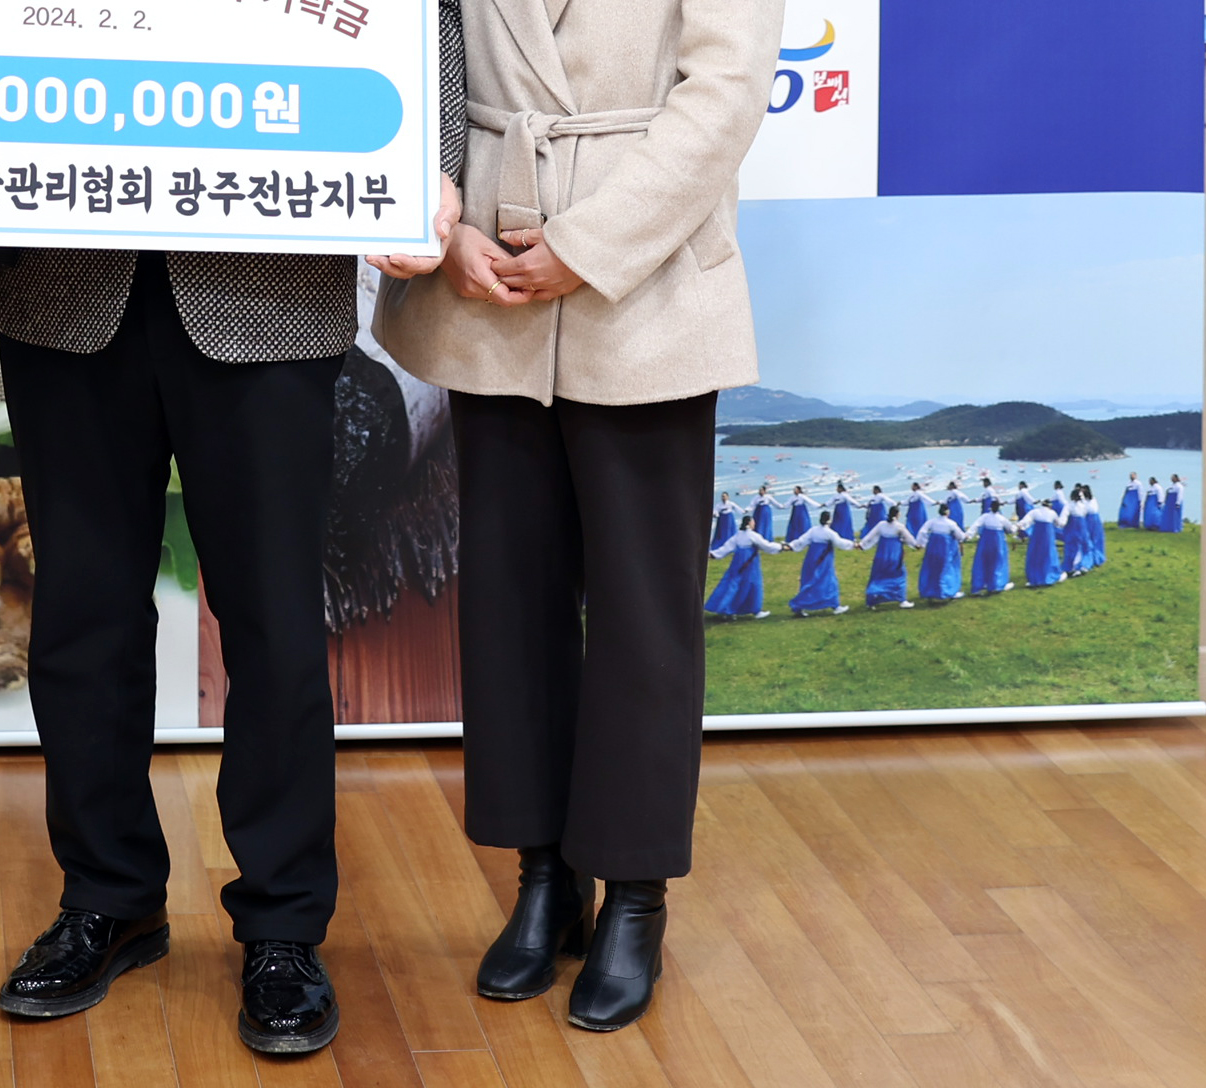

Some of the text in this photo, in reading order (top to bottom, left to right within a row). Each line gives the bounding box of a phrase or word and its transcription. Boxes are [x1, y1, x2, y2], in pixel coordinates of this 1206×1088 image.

[22, 6, 153, 31] 2024. 2. 2.
[168, 170, 397, 221] 광주전남지부
